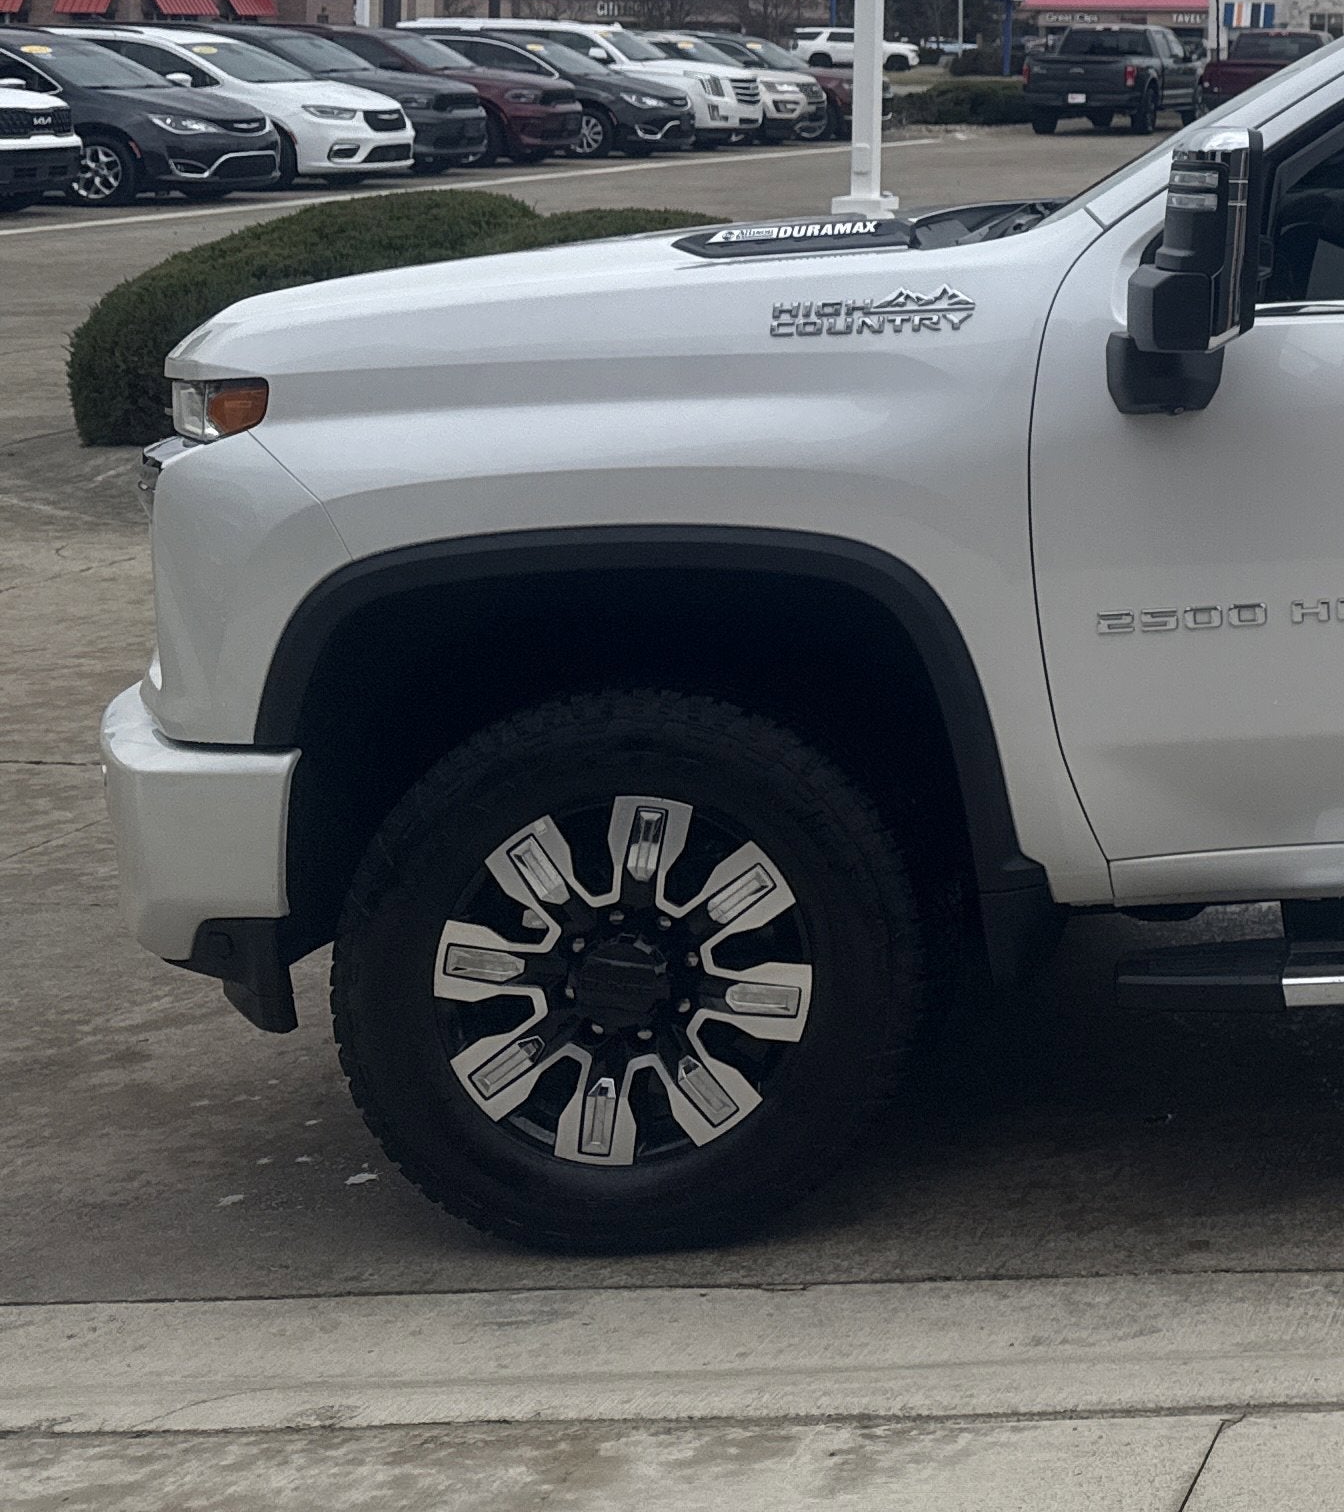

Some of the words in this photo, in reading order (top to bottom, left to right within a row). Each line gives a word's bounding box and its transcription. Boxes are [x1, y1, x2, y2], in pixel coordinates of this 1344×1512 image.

[778, 221, 879, 238] DURAMAX
[772, 298, 874, 319] HIGH
[770, 313, 973, 337] COUNTRY
[1097, 602, 1268, 635] 2500
